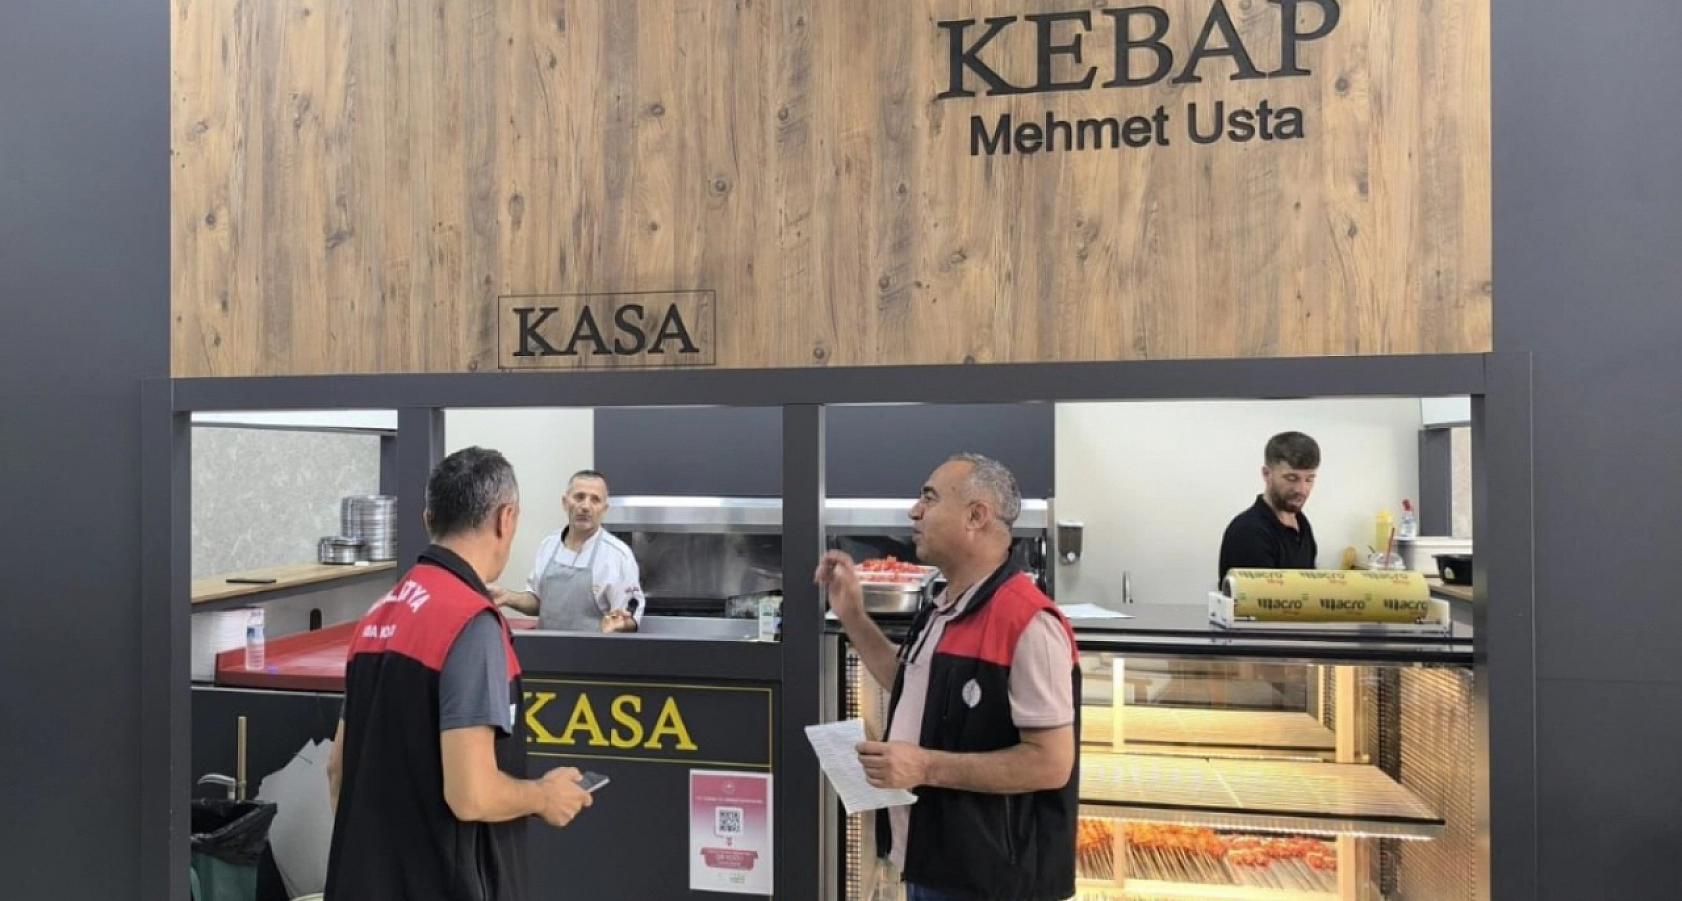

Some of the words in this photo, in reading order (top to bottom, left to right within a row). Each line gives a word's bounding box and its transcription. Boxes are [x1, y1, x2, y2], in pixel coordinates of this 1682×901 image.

[937, 0, 1340, 99] KEBAP
[970, 106, 1169, 156] Mehmet
[1187, 99, 1305, 145] Usta
[512, 303, 700, 357] KASA
[523, 692, 698, 750] KASA
